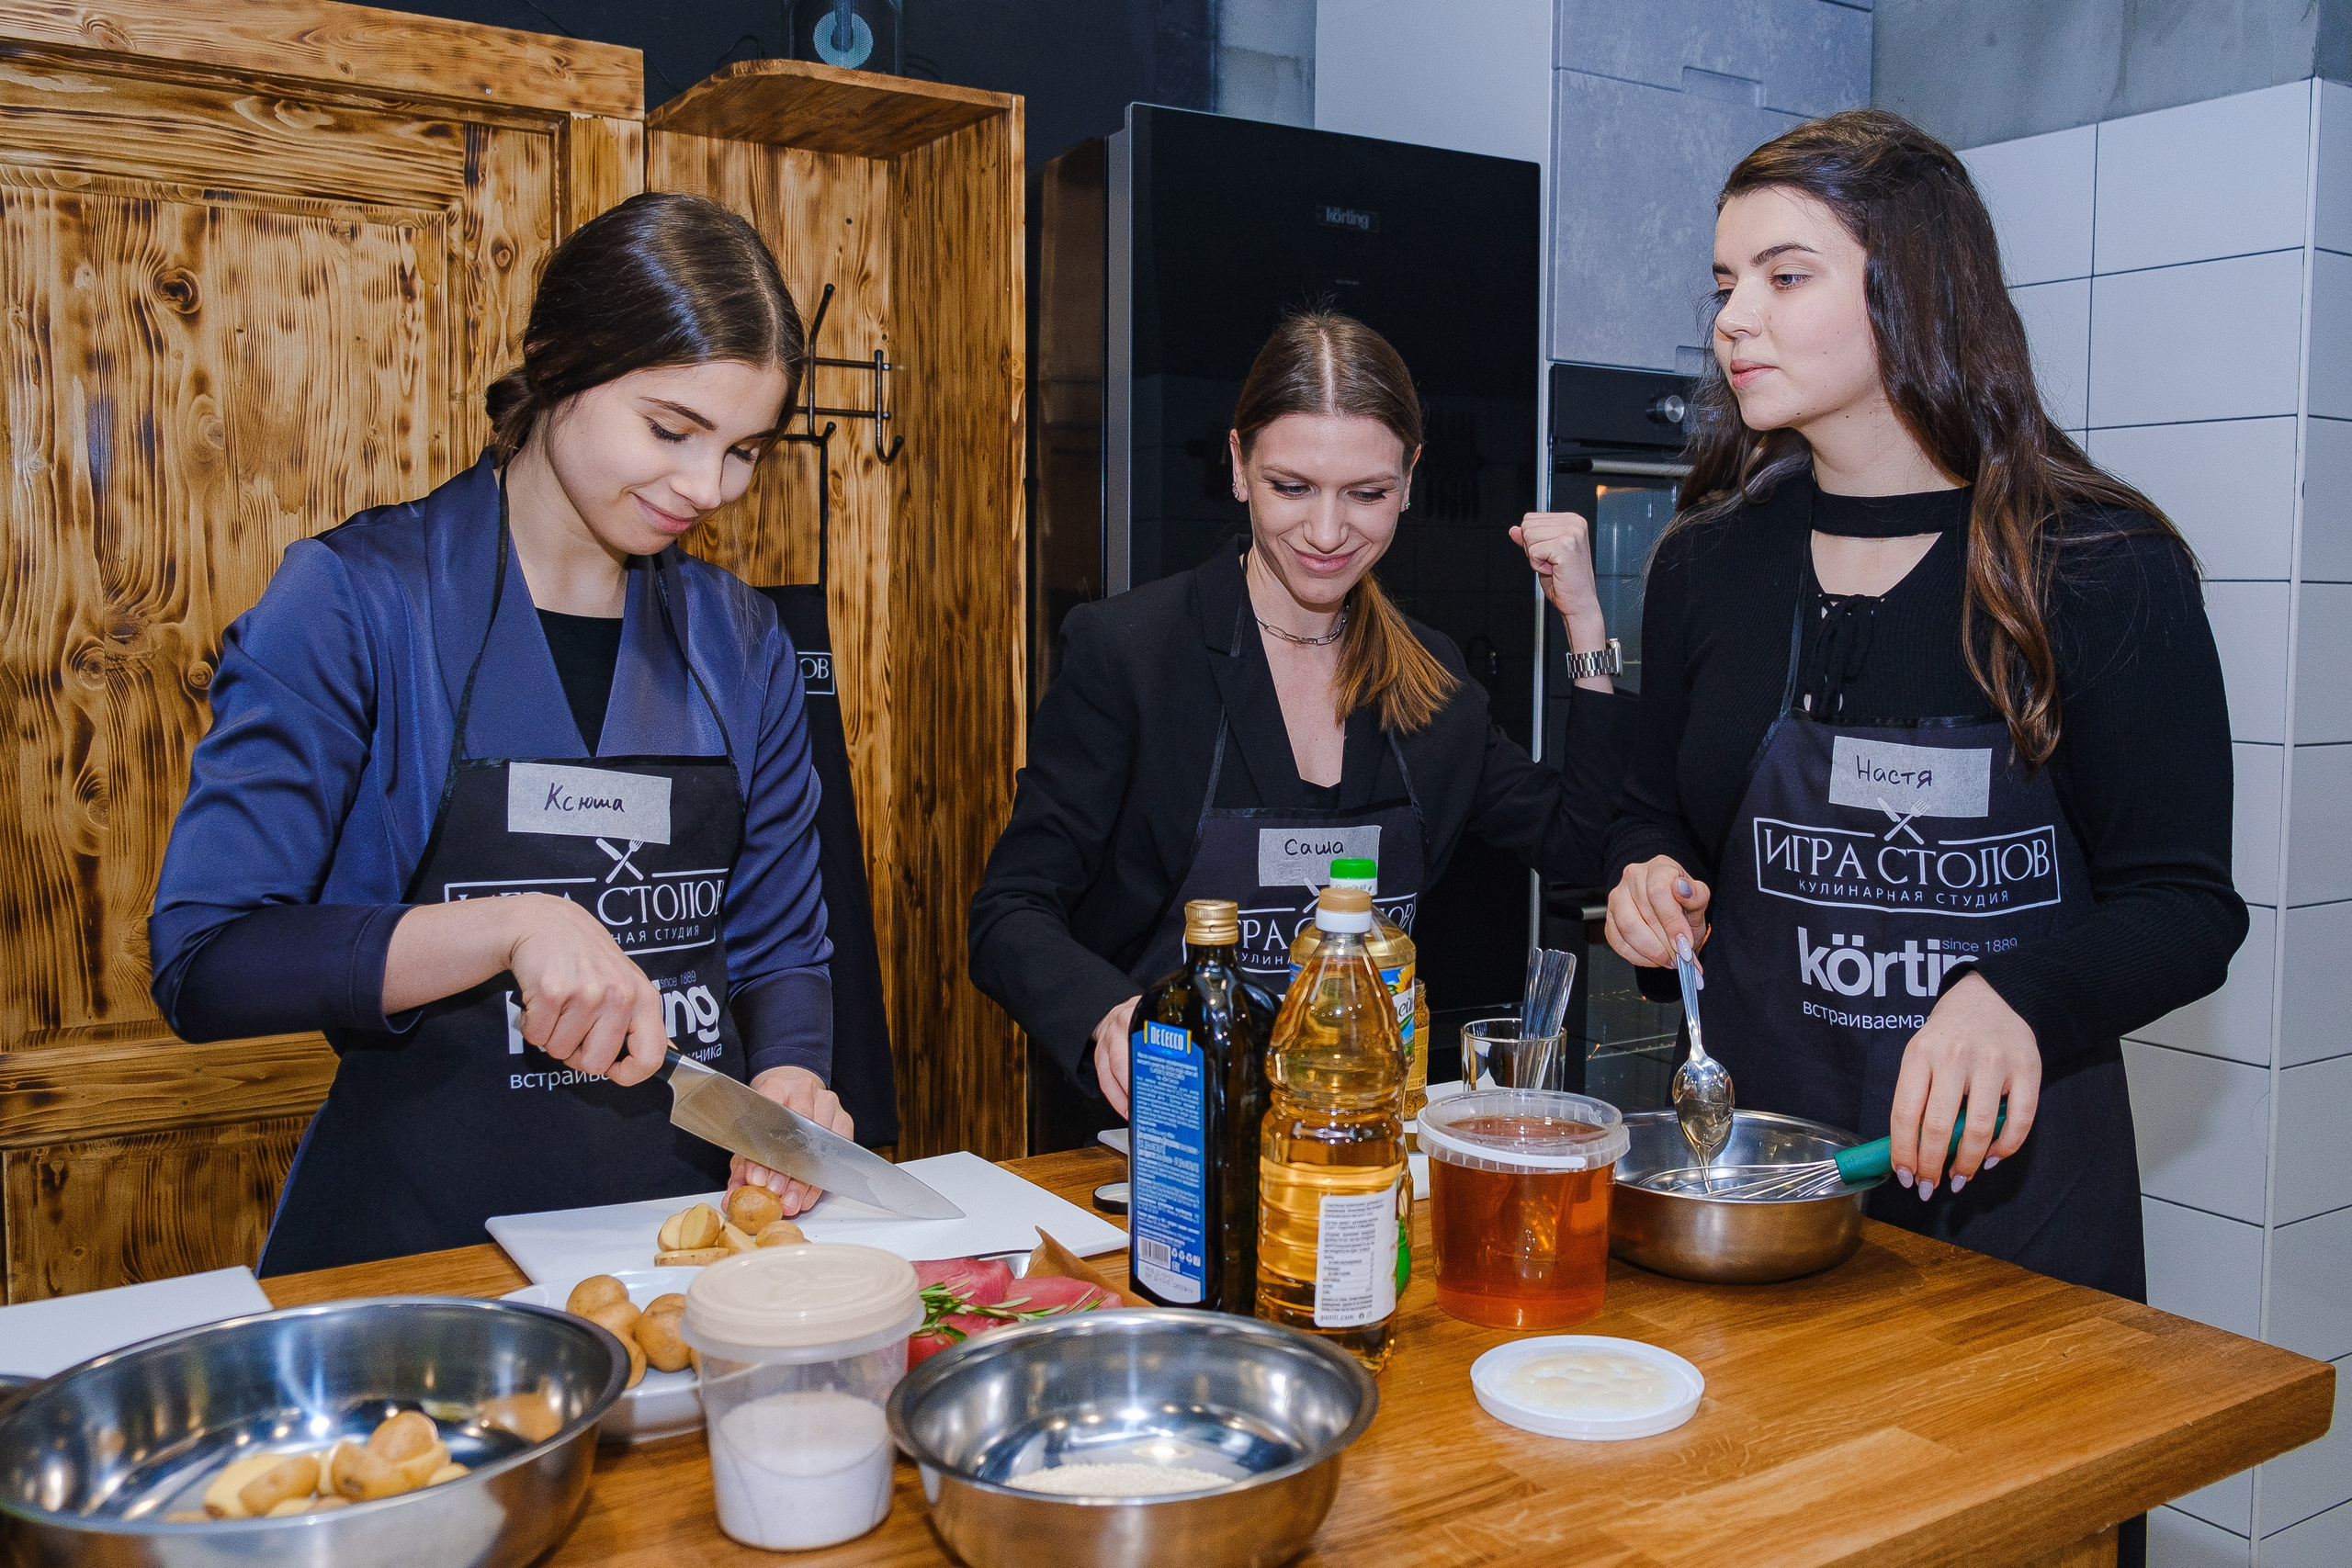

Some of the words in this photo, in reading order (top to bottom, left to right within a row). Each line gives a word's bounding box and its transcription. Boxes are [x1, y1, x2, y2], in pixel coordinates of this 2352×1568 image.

[1856, 754, 1933, 789] Настя
[544, 782, 626, 814] Ксюша
[1284, 838, 1344, 855] Саша
[1764, 829, 1868, 880] ИГРА
[1877, 839, 2051, 889] СТОЛОВ
[1798, 879, 1924, 902] КУЛИНАРНАЯ
[1936, 890, 2009, 908] СТУДИЯ
[655, 924, 699, 941] СТУДИЯ
[1941, 937, 1979, 953] since
[1797, 926, 1980, 997] körti
[660, 976, 678, 987] since
[680, 970, 696, 985] 1889
[1803, 1000, 1930, 1030] встраиваема
